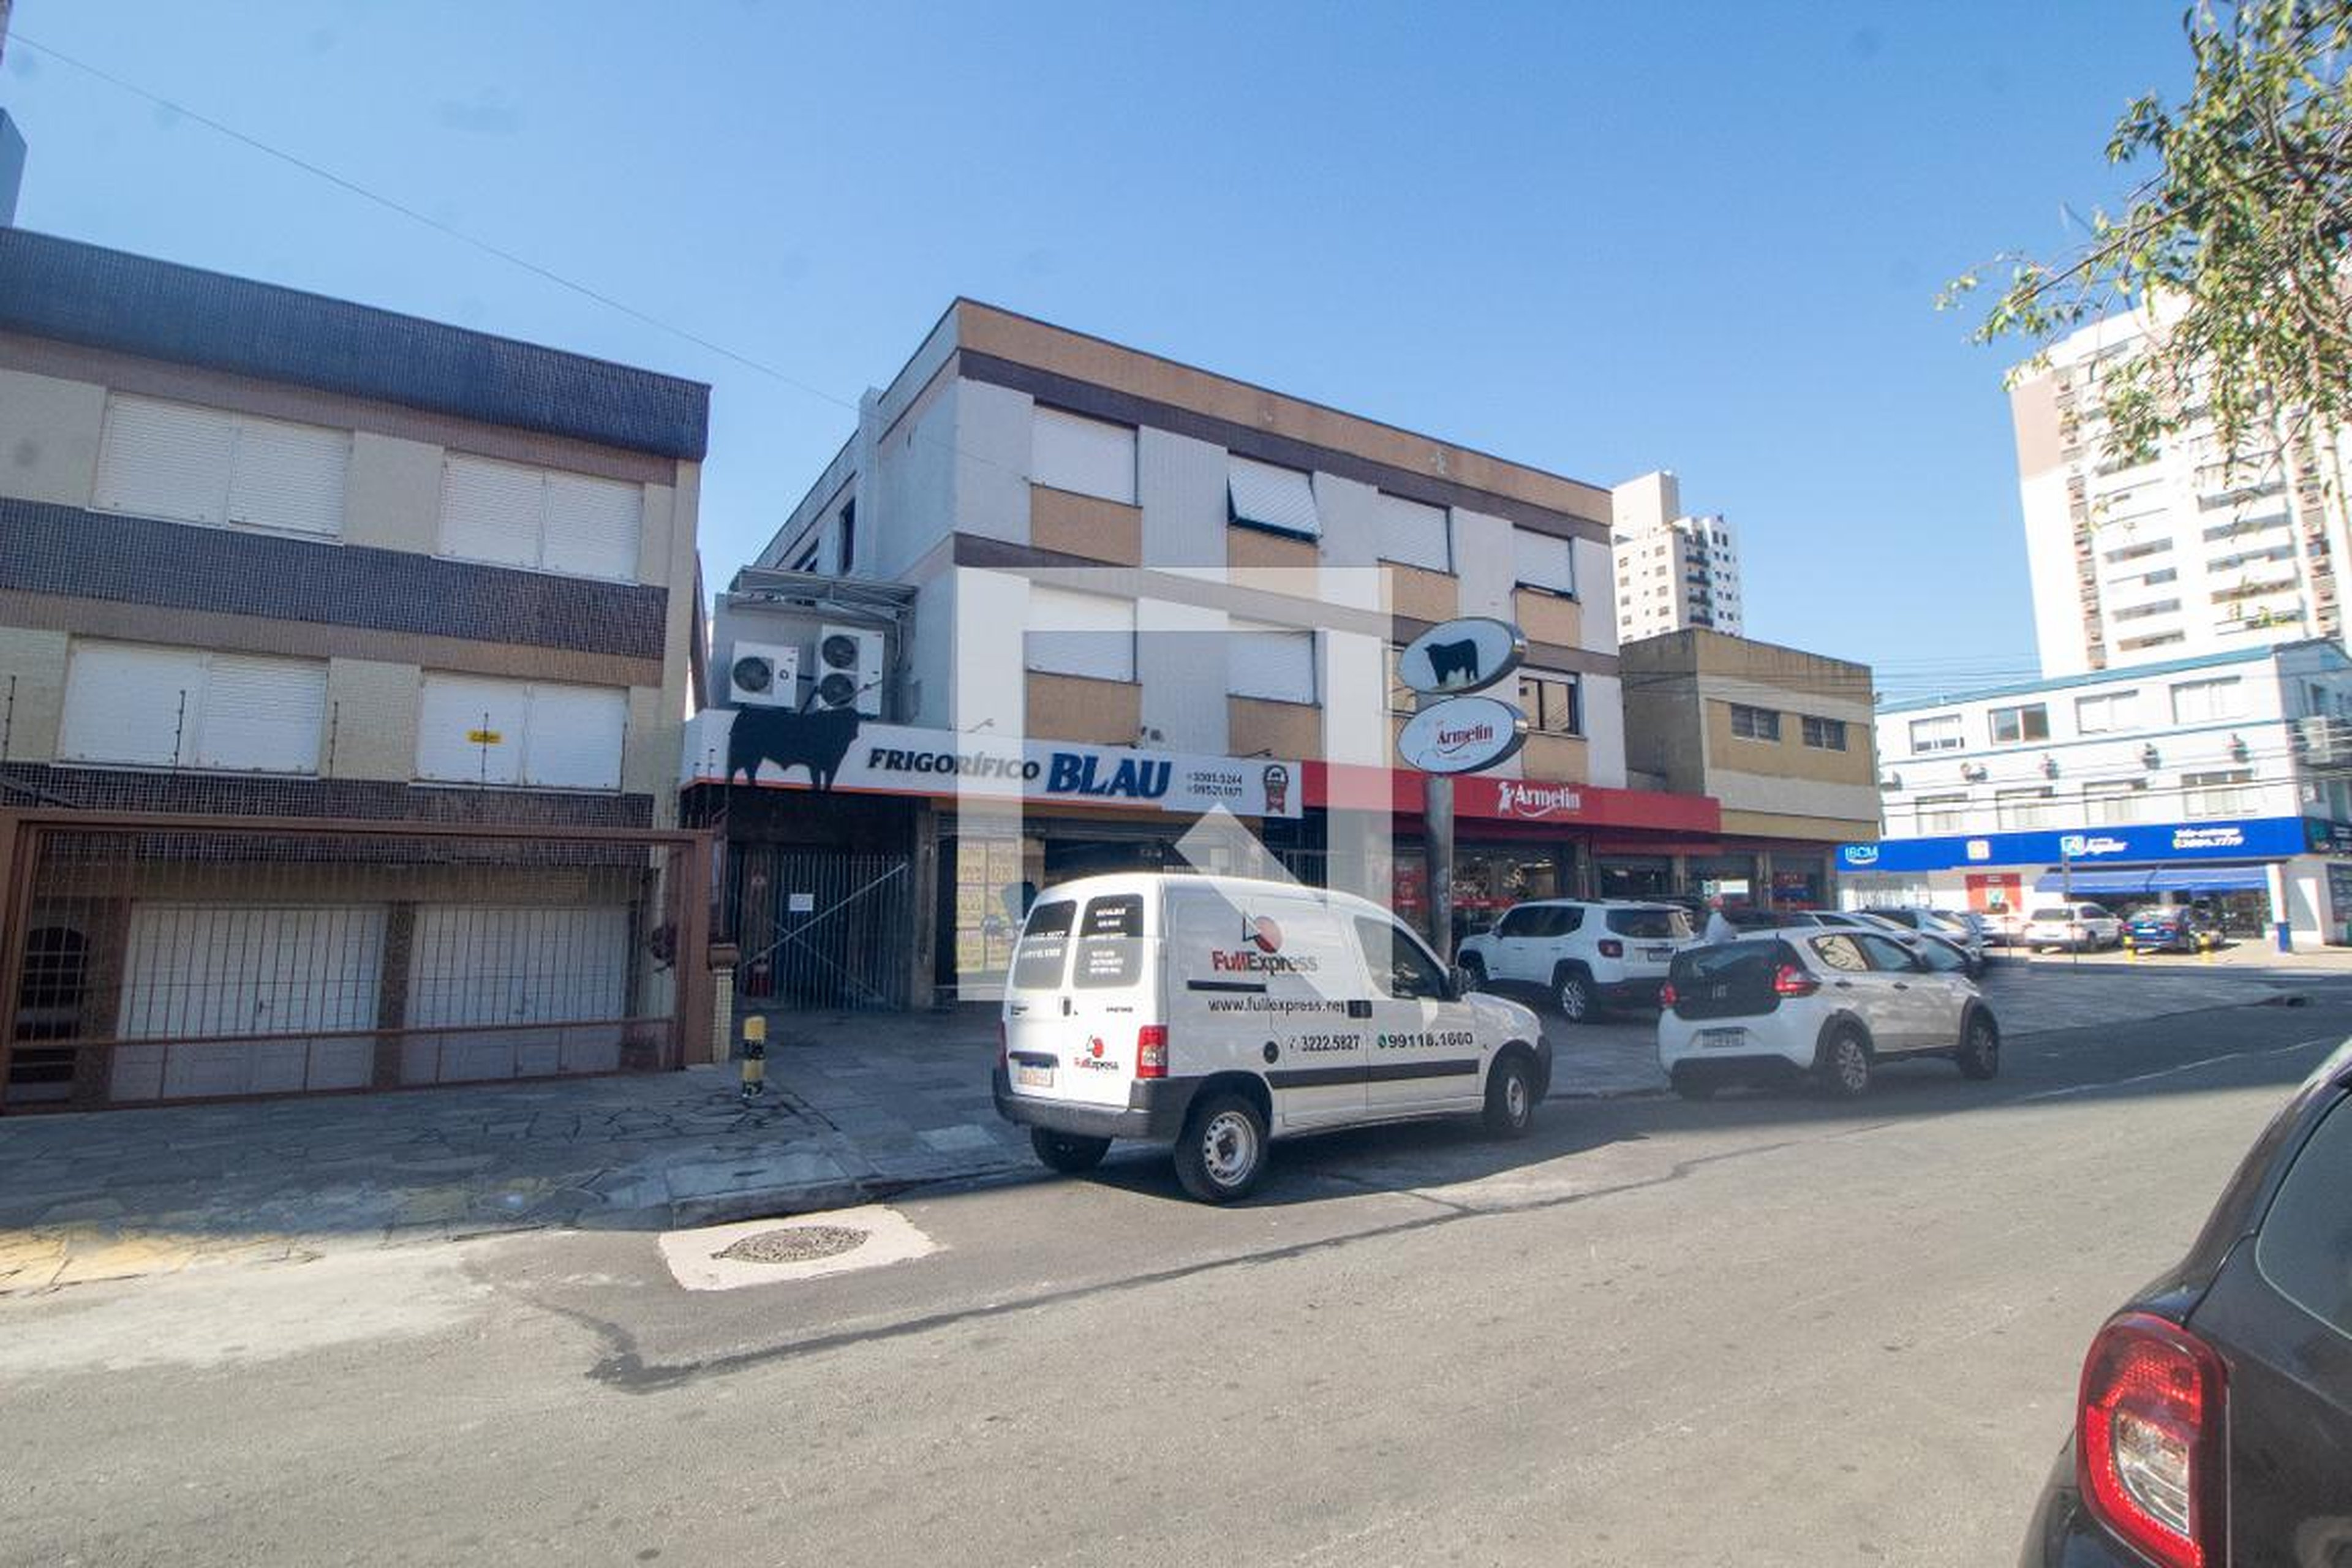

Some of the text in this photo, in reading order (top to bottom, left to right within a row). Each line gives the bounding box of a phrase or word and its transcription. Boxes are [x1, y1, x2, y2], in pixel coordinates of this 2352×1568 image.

[1437, 723, 1493, 745] Armelin
[867, 747, 1172, 798] FRIGORÍFICO BLAU
[1515, 784, 1581, 809] Armelin
[1212, 951, 1319, 975] FullExpress
